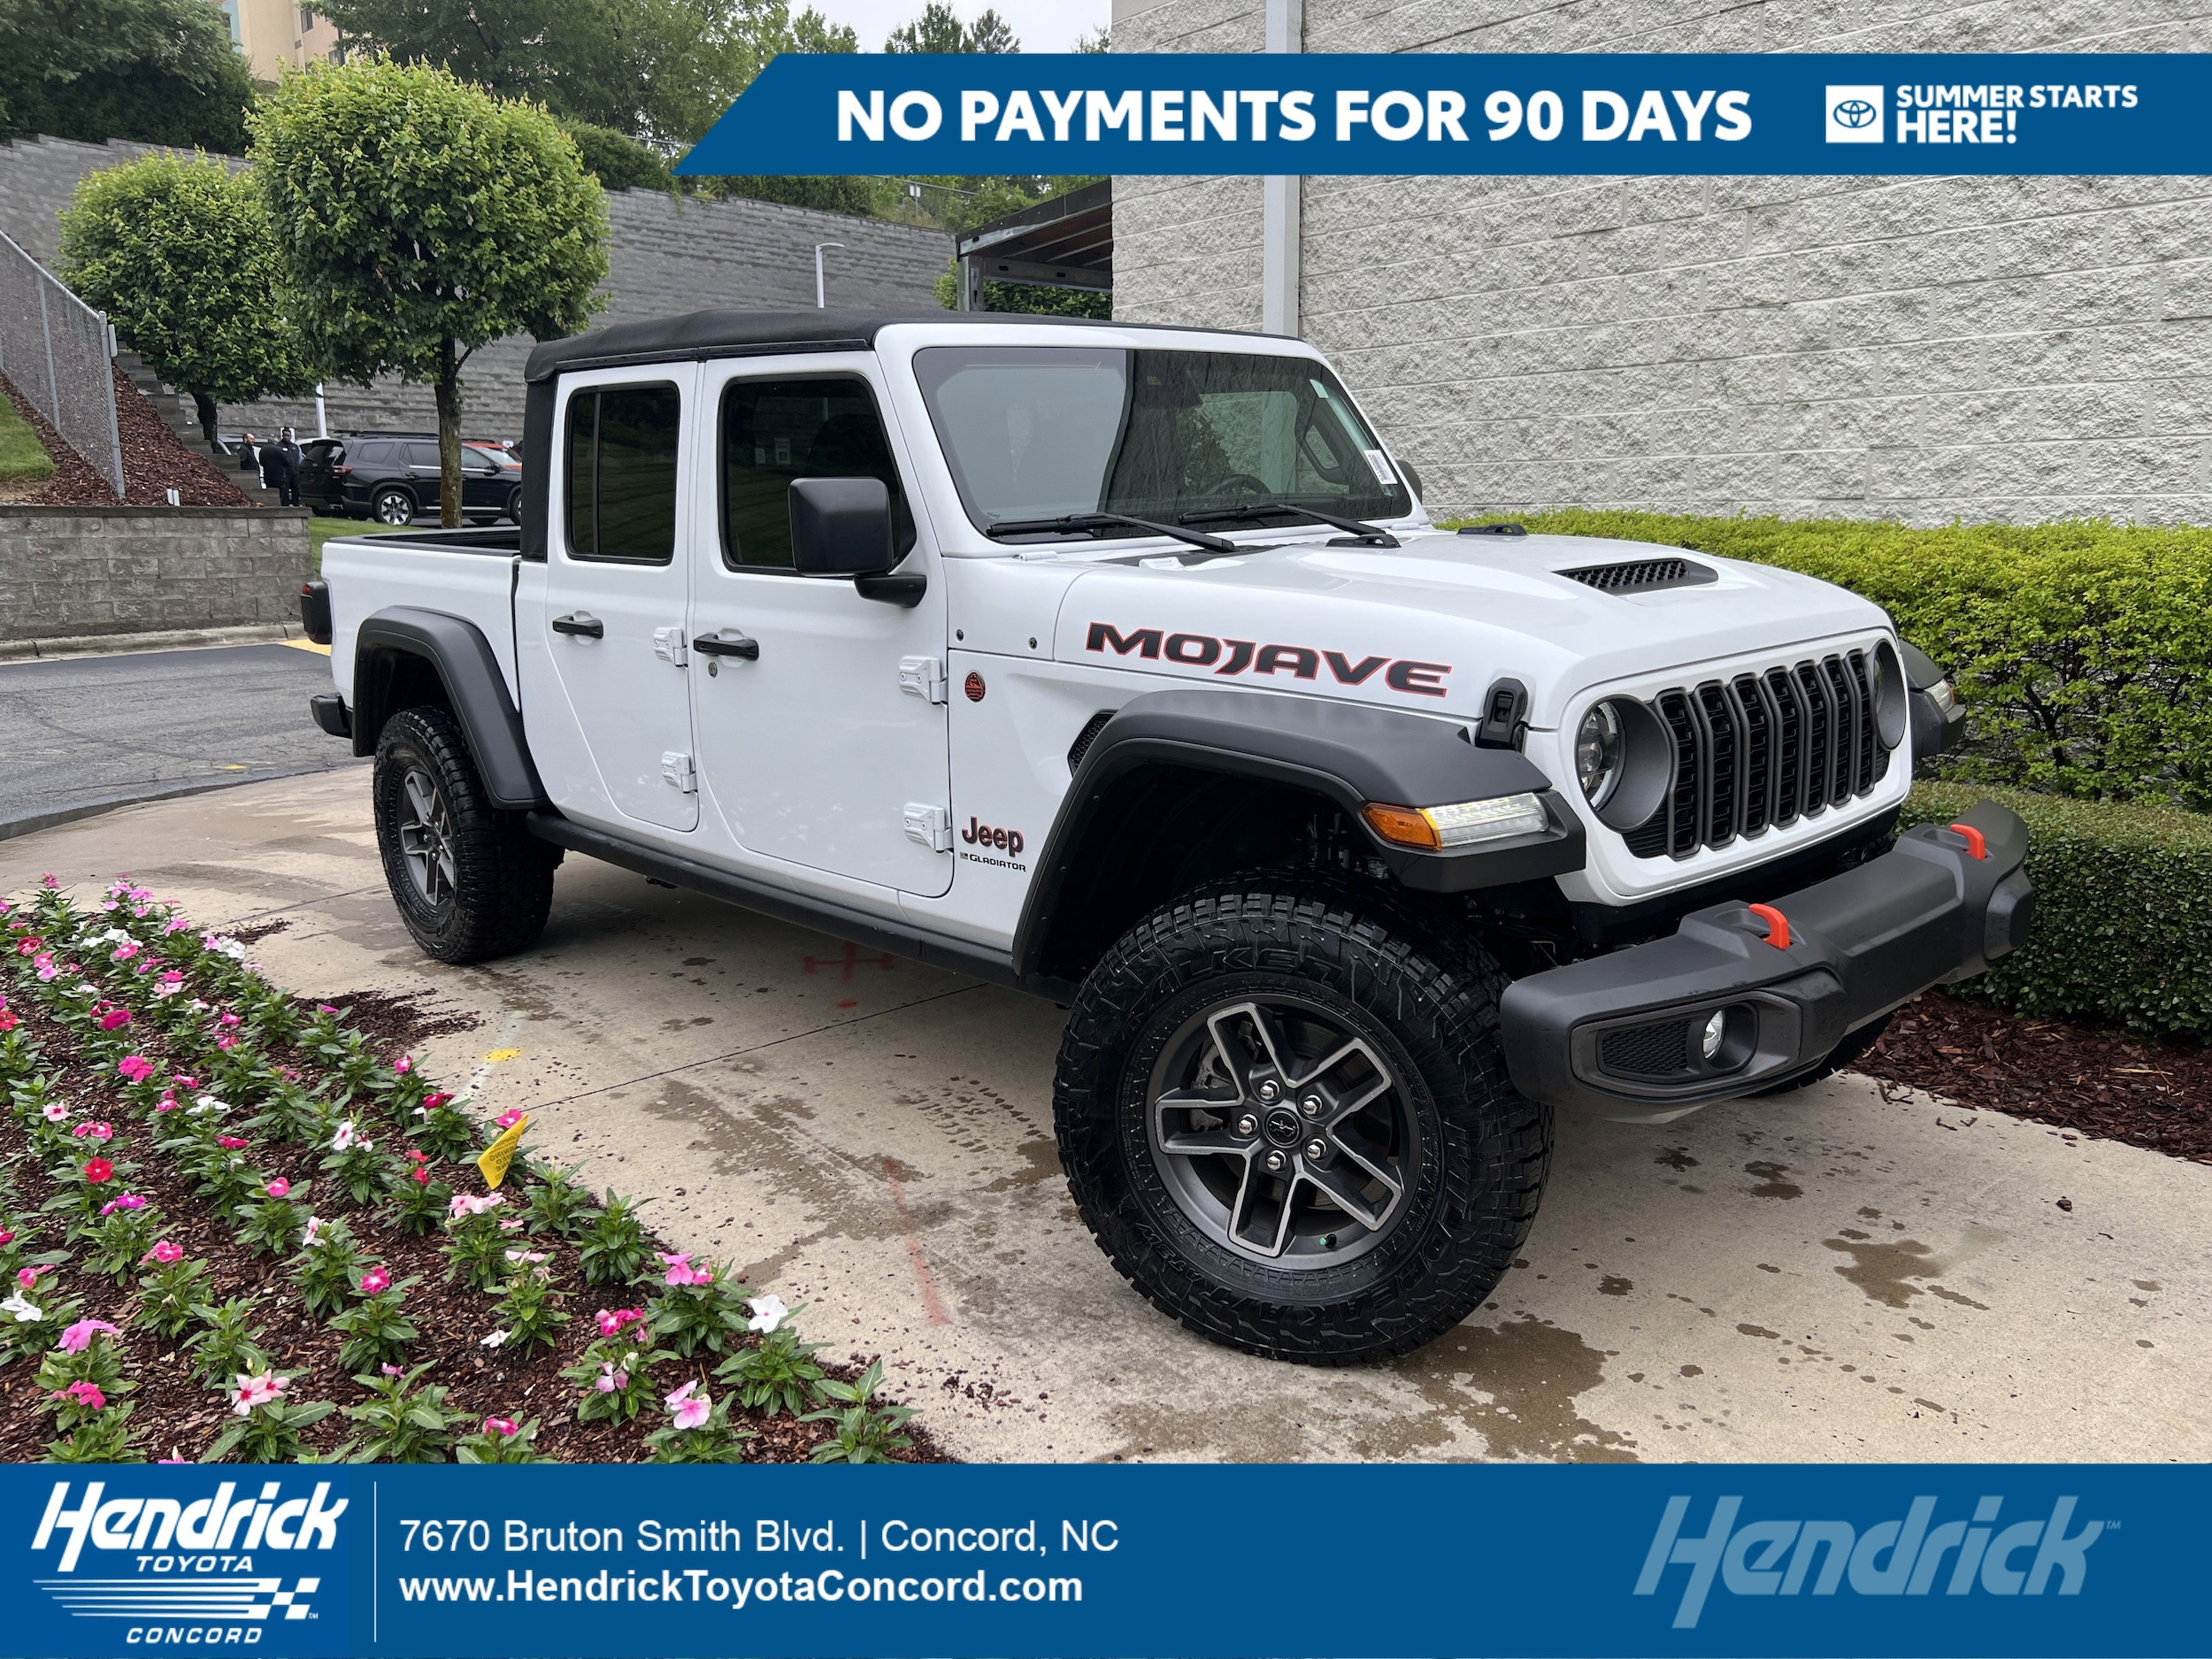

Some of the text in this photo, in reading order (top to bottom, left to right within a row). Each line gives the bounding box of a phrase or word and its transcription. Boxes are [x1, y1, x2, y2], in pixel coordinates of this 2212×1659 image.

[1086, 622, 1452, 697] MOJAVE
[962, 816, 1024, 857] Jeep
[970, 854, 1026, 872] GLADIATOR
